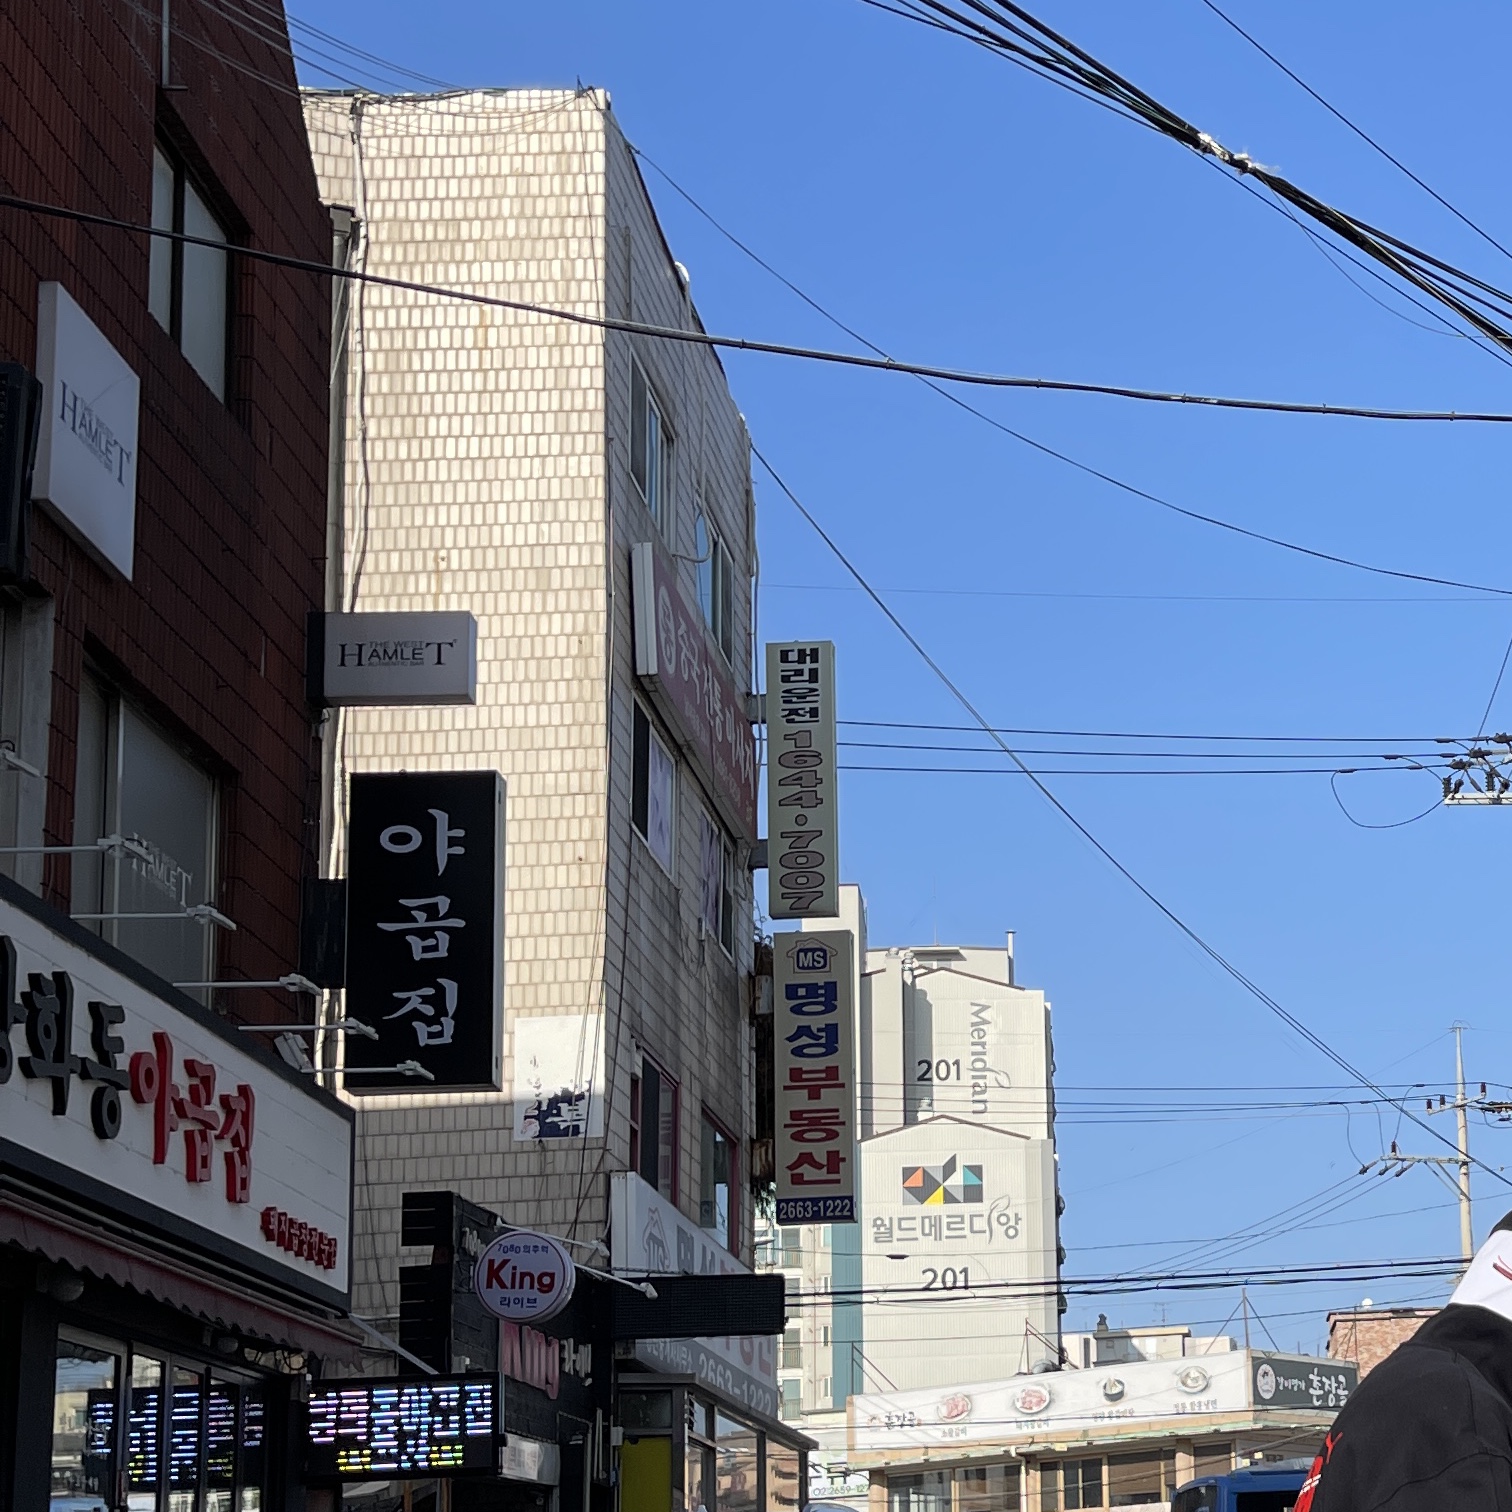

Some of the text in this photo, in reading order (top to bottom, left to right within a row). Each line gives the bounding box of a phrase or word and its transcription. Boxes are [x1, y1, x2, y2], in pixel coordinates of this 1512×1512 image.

[338, 639, 455, 667] HAMLET
[778, 647, 821, 724] 대리운전
[377, 808, 466, 1047] 야곱집
[799, 952, 824, 968] MS
[917, 1059, 961, 1082] 201
[967, 1002, 997, 1114] Meridian
[783, 981, 847, 1186] 명성부동산
[779, 1198, 851, 1220] 2663-1222
[872, 1206, 1022, 1244] 월드메르디앙
[486, 1258, 556, 1294] King
[922, 1267, 969, 1291] 201
[500, 1296, 538, 1309] 라이브
